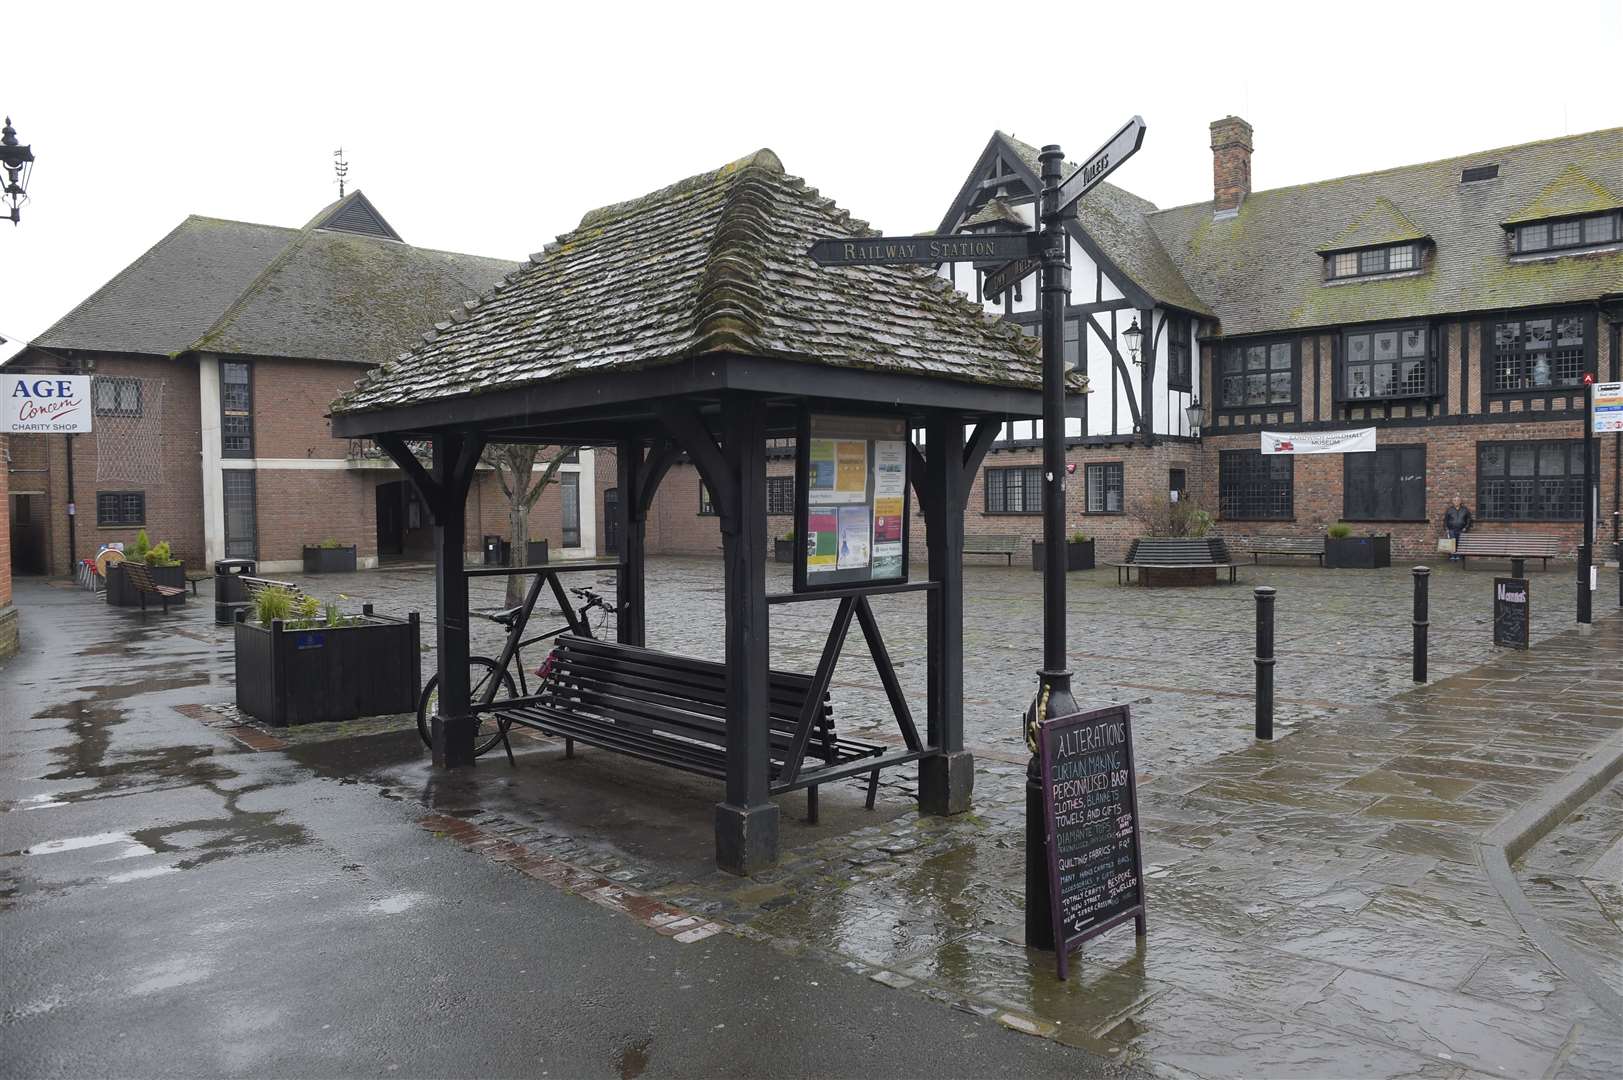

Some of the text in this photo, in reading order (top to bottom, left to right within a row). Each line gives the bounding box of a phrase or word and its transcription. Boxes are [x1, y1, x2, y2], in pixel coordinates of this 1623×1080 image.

[843, 241, 995, 260] RAILWAY STATION
[12, 380, 74, 398] AGE
[20, 399, 82, 421] Concern
[1057, 723, 1126, 759] ALTERATIONS
[1051, 751, 1120, 781] CURTAIN MAKING
[1053, 769, 1128, 800] PERSONALISED BABY
[1087, 790, 1119, 807] BLANKETS
[1056, 803, 1122, 828] TOWELS AND GIFTS
[1107, 869, 1131, 889] BESPOKE
[1062, 885, 1105, 906] TOTALLY CRAFTY
